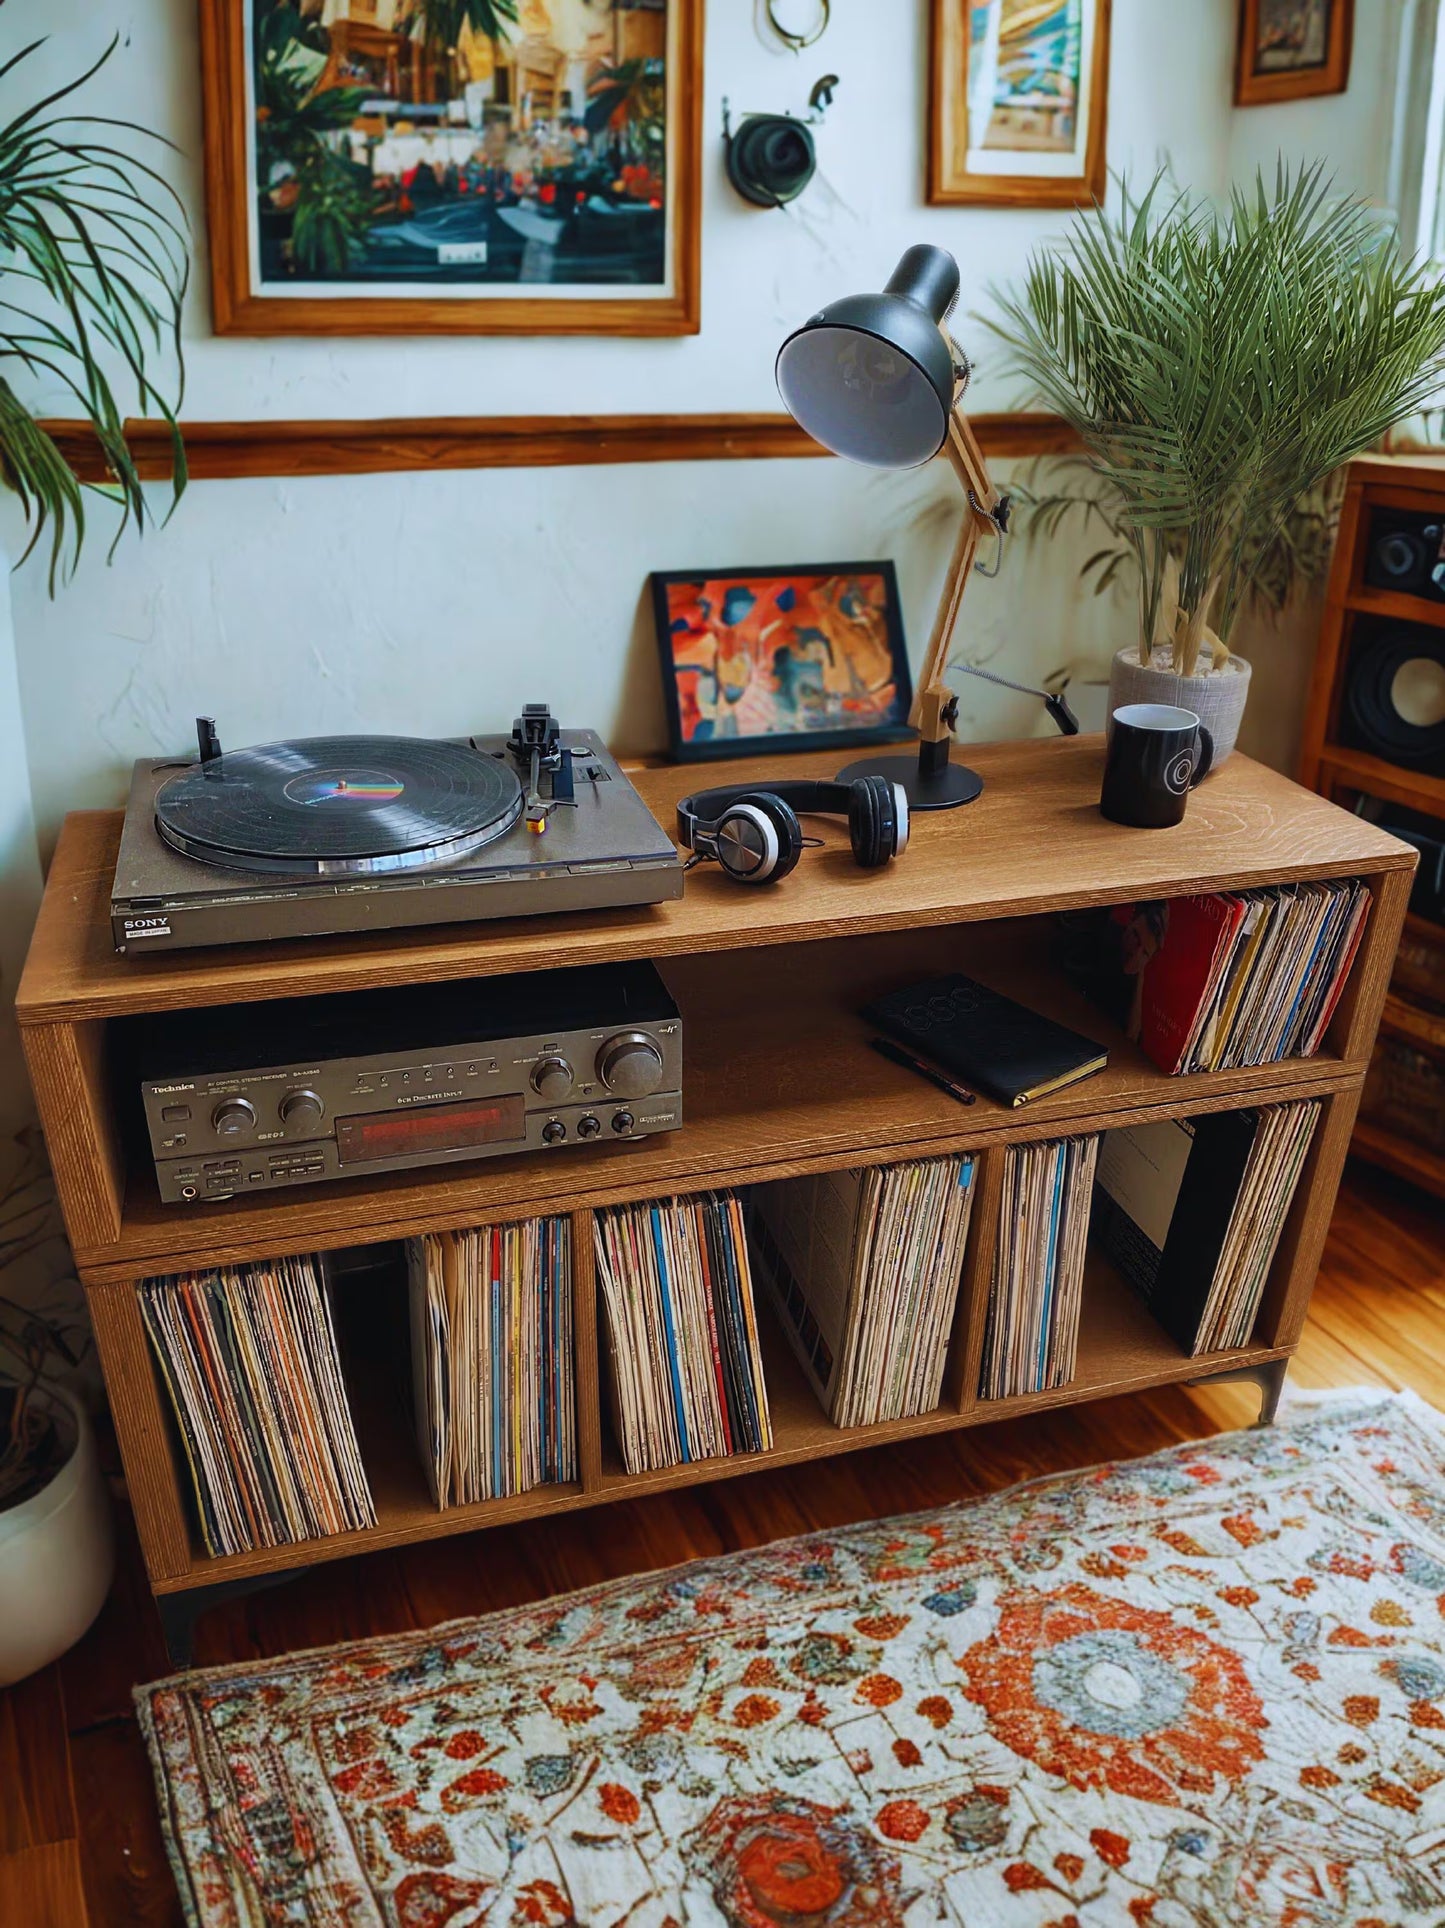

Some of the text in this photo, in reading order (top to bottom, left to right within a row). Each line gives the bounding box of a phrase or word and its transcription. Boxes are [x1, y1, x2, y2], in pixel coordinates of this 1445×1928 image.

[124, 917, 168, 929] SONY
[151, 1083, 195, 1094] Technics
[443, 1090, 463, 1098] INPUT
